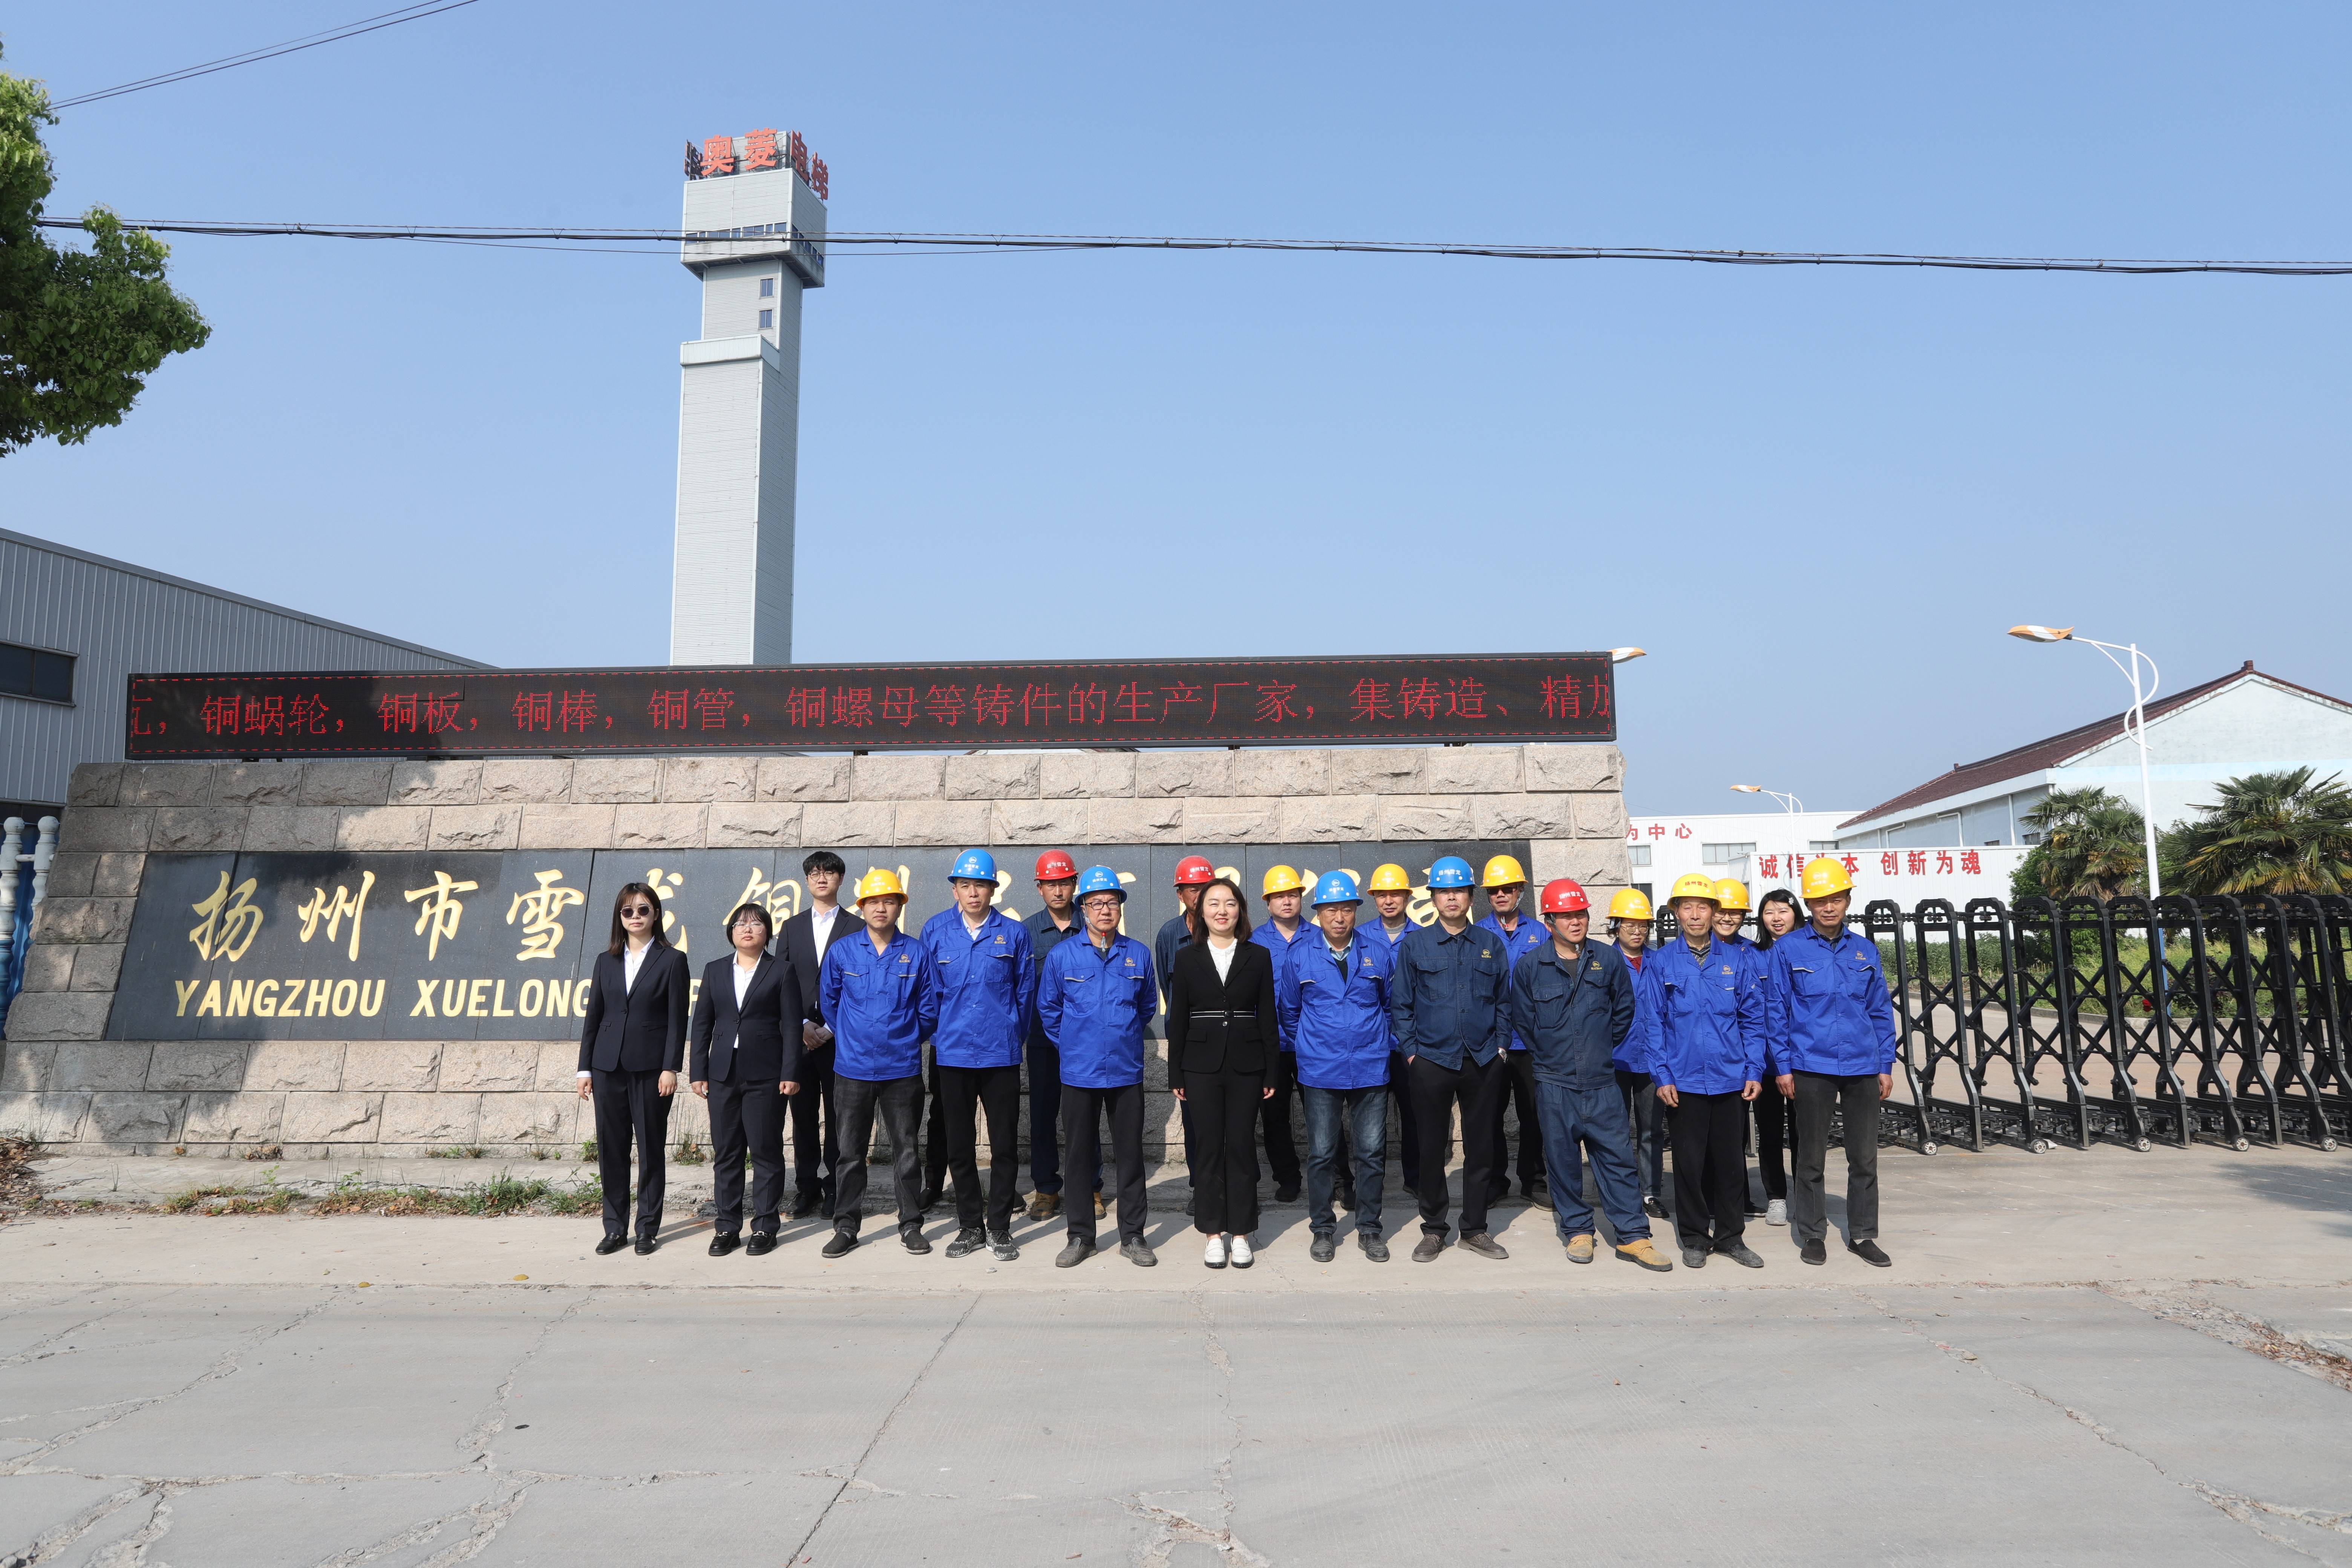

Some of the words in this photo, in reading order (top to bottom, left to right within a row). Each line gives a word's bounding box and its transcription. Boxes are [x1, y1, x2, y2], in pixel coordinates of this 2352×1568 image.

[700, 127, 777, 176] 奥菱
[791, 129, 828, 200] 电梯
[1759, 852, 1859, 879] 诚信本
[1881, 849, 1981, 876] 创新为魂
[175, 979, 386, 1017] YANGZHOU
[410, 979, 593, 1017] XUELONG
